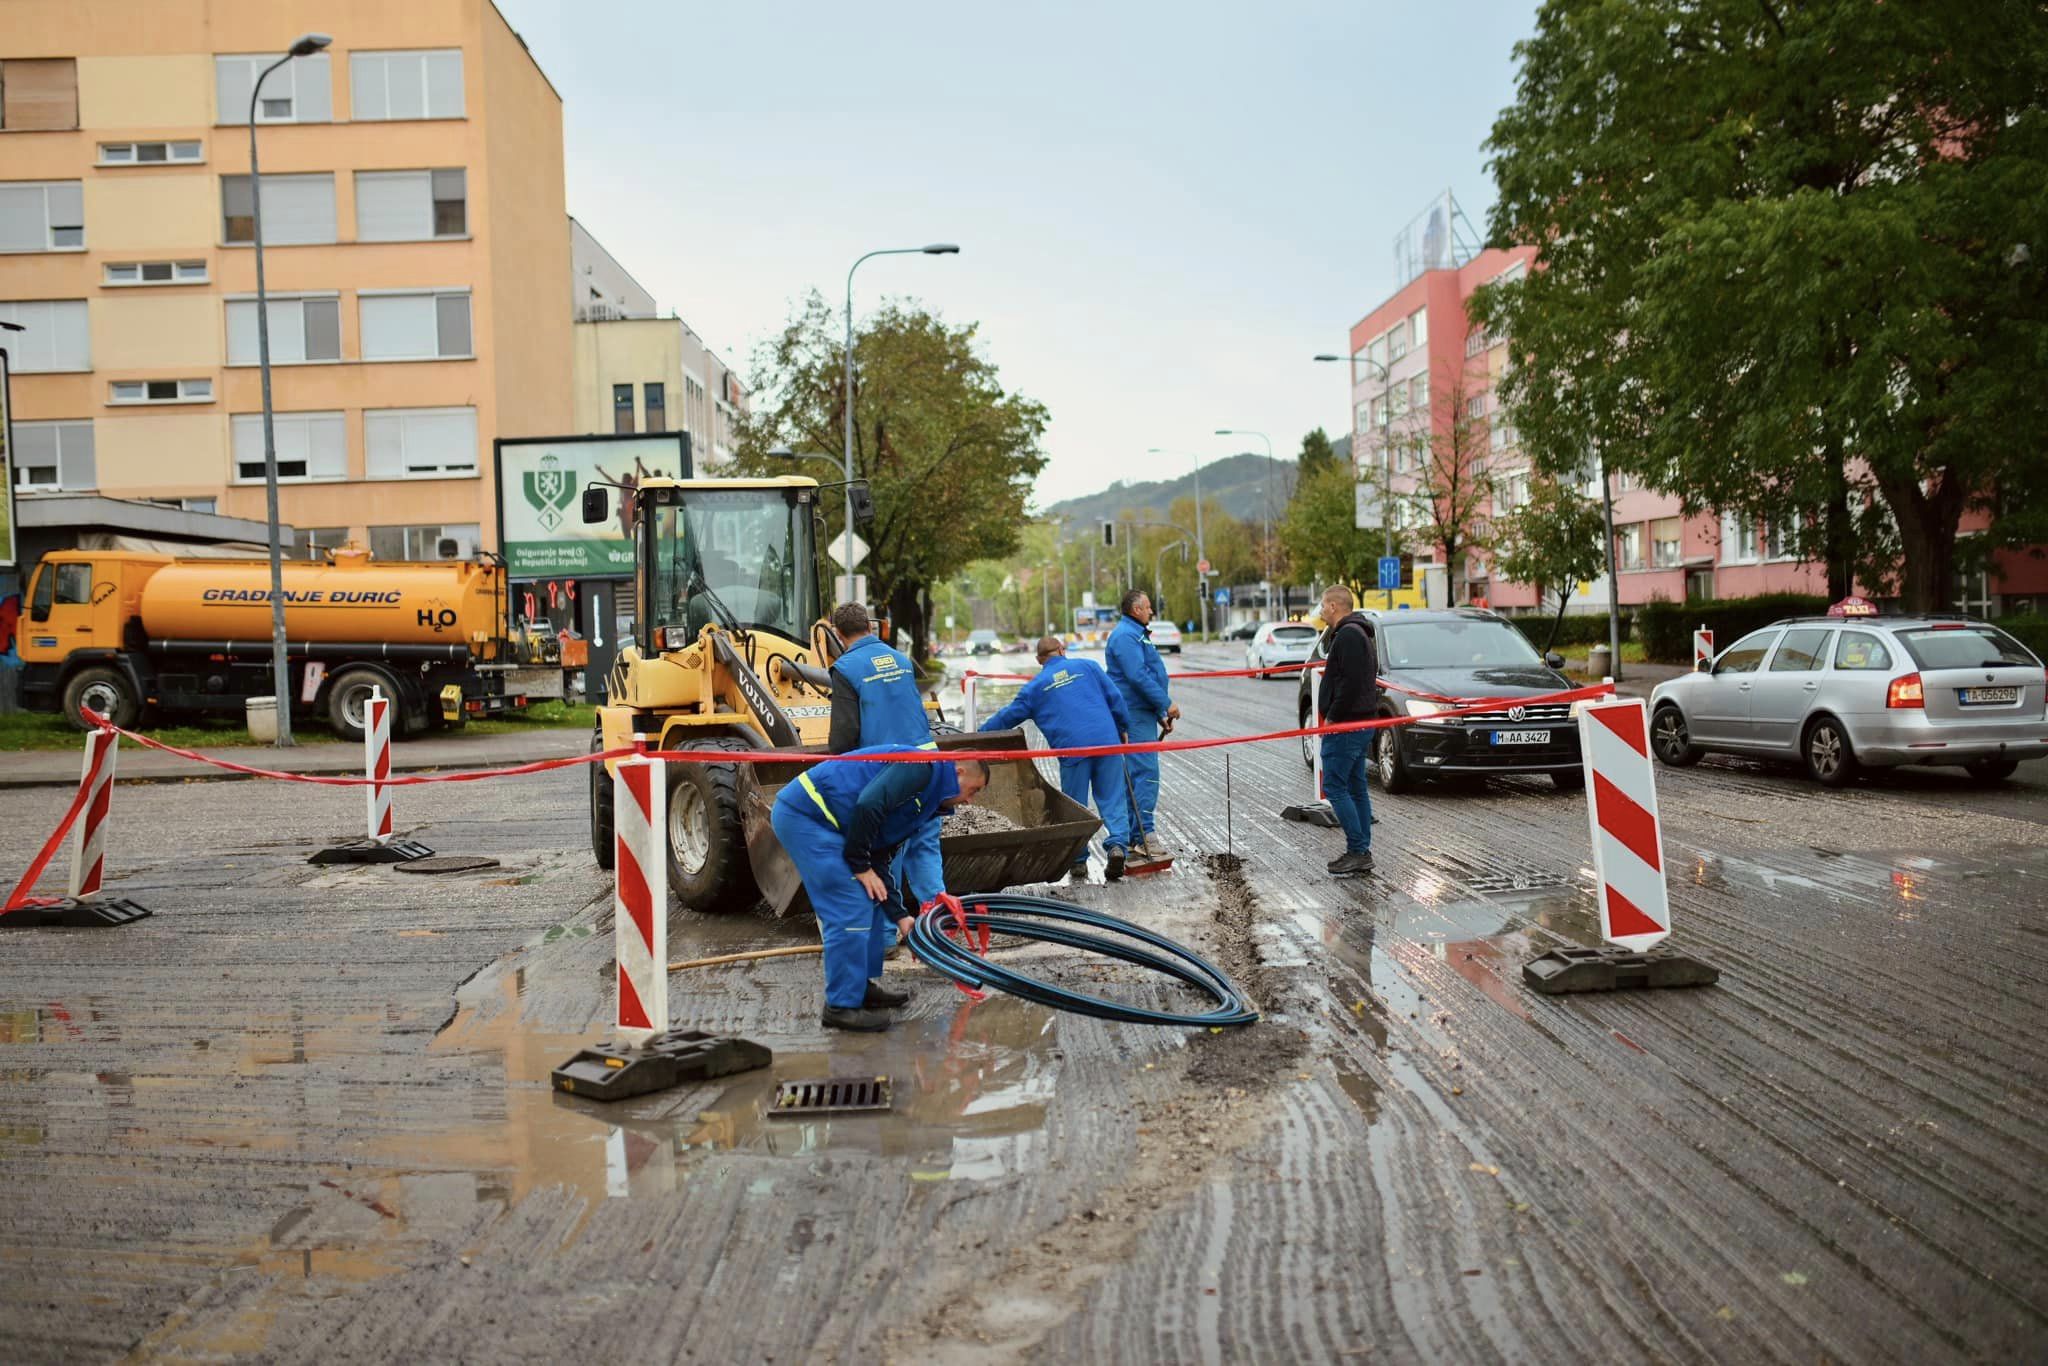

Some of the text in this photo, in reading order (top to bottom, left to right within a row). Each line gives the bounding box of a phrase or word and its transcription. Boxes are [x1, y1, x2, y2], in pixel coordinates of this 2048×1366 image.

[558, 546, 575, 558] broj
[329, 588, 401, 604] ĐURIĆ
[1842, 604, 1869, 615] TAXI
[738, 668, 775, 727] VOLVO
[1497, 732, 1549, 743] M AA 3427
